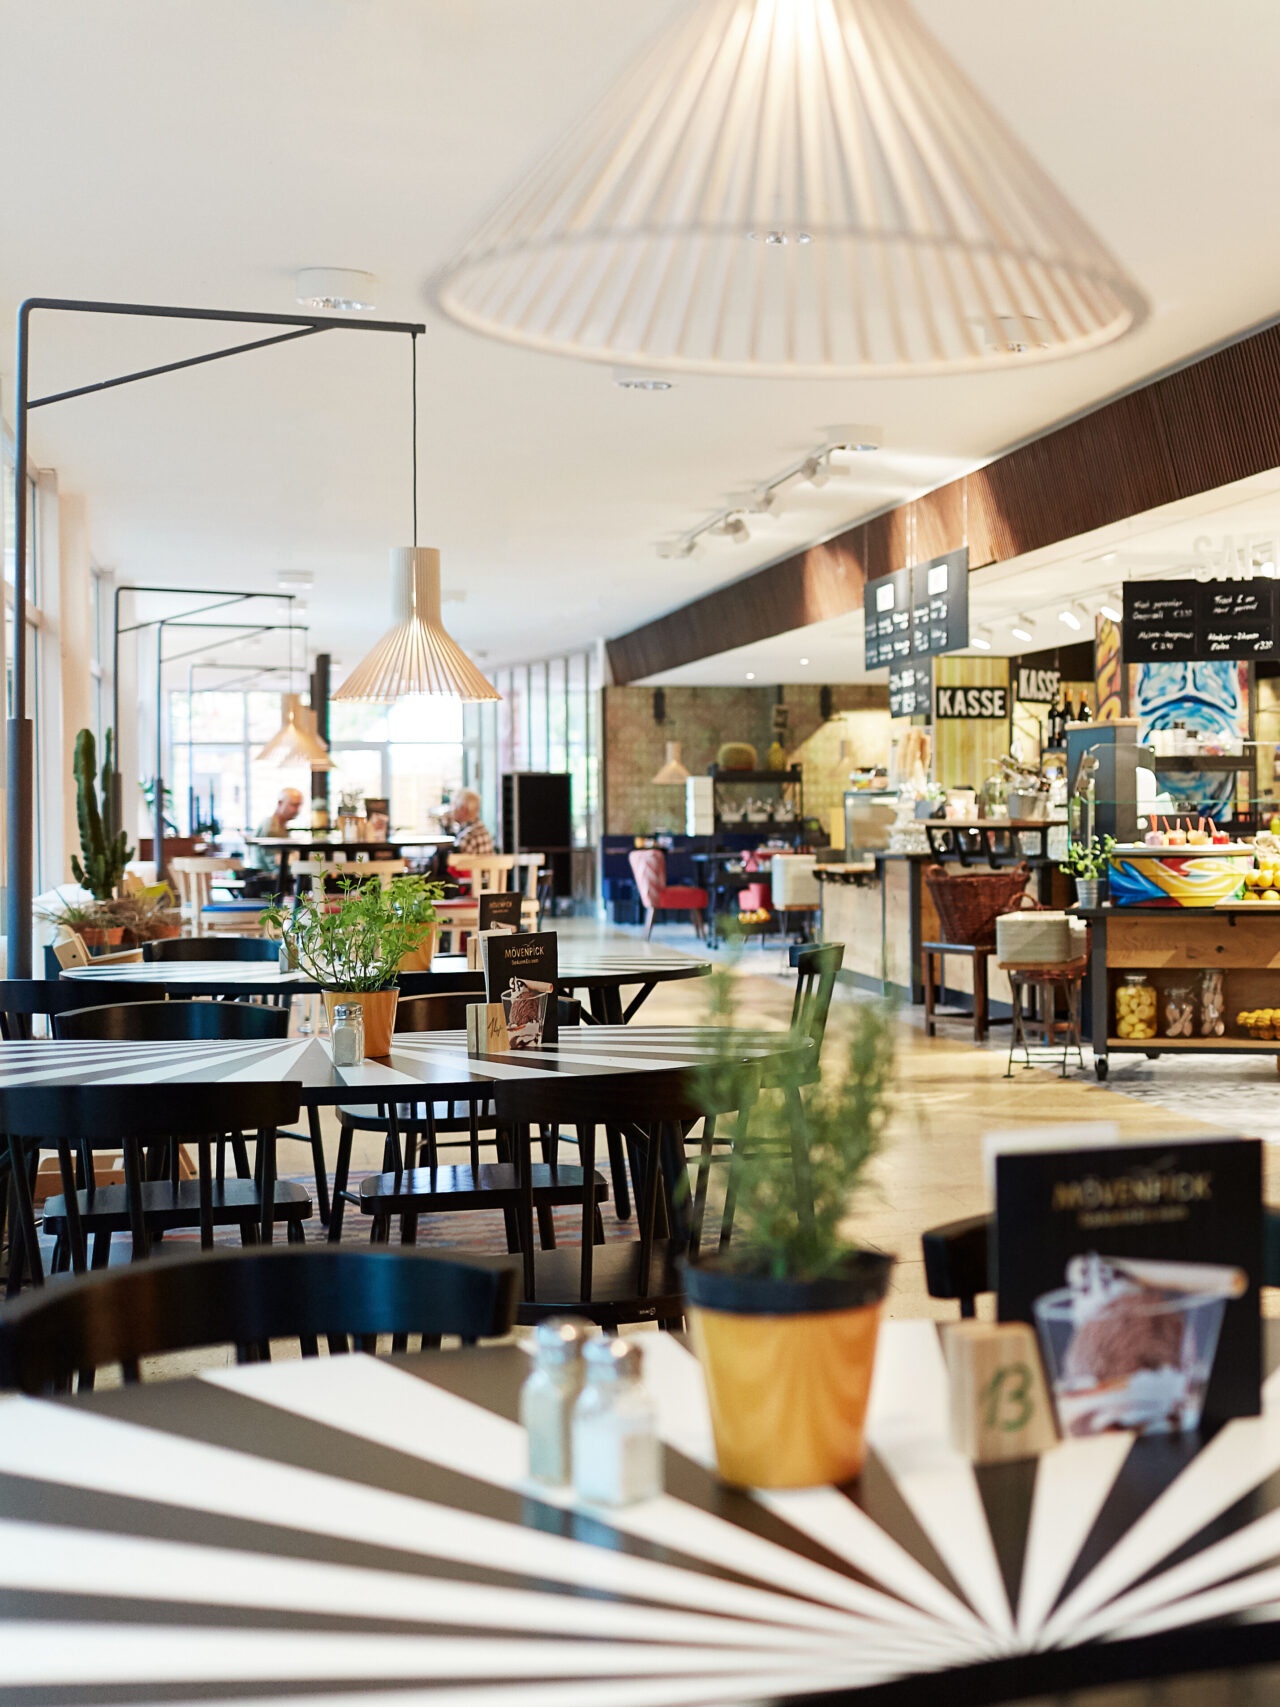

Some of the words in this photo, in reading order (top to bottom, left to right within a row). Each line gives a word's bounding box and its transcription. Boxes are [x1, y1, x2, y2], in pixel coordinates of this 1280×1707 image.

[1019, 668, 1061, 700] KASSE
[938, 689, 1006, 716] KASSE
[504, 945, 545, 959] MÖVENPICK
